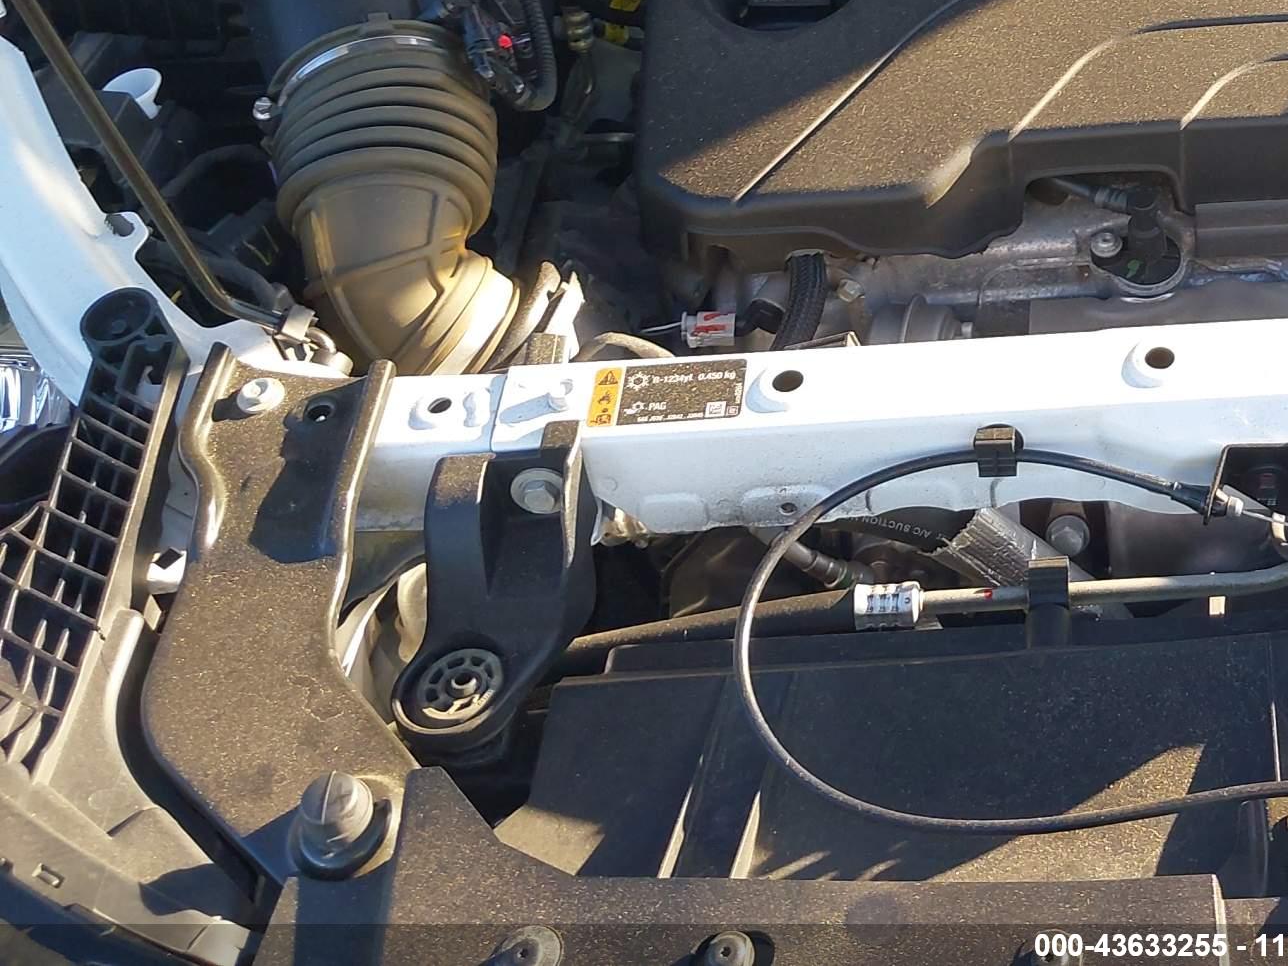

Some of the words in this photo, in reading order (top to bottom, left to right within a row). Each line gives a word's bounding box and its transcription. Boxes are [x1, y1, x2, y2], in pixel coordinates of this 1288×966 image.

[723, 369, 737, 381] kg
[648, 401, 667, 411] PAG
[862, 515, 911, 533] SUCTION
[912, 527, 932, 539] A/C
